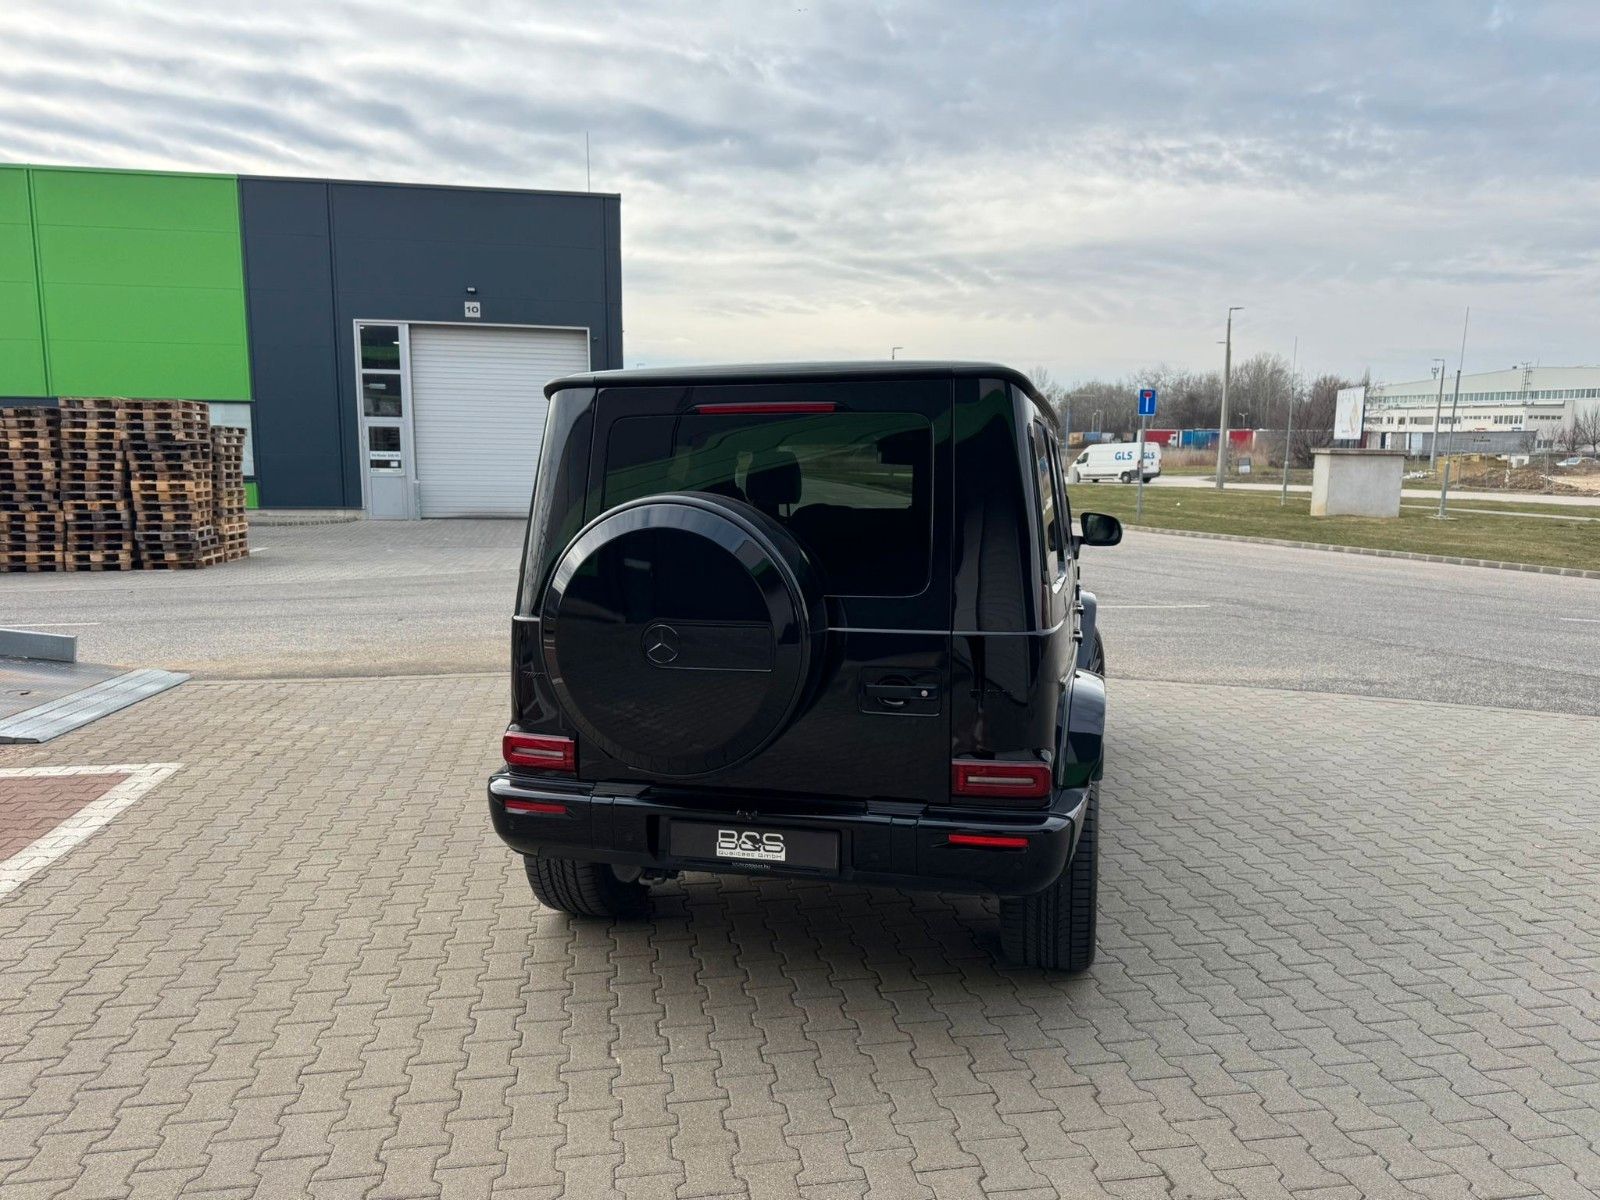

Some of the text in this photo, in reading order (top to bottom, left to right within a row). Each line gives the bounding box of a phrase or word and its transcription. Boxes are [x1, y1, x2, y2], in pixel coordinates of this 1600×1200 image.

[1115, 451, 1133, 460] GLS
[718, 829, 784, 853] B&S
[757, 852, 783, 860] GmbH
